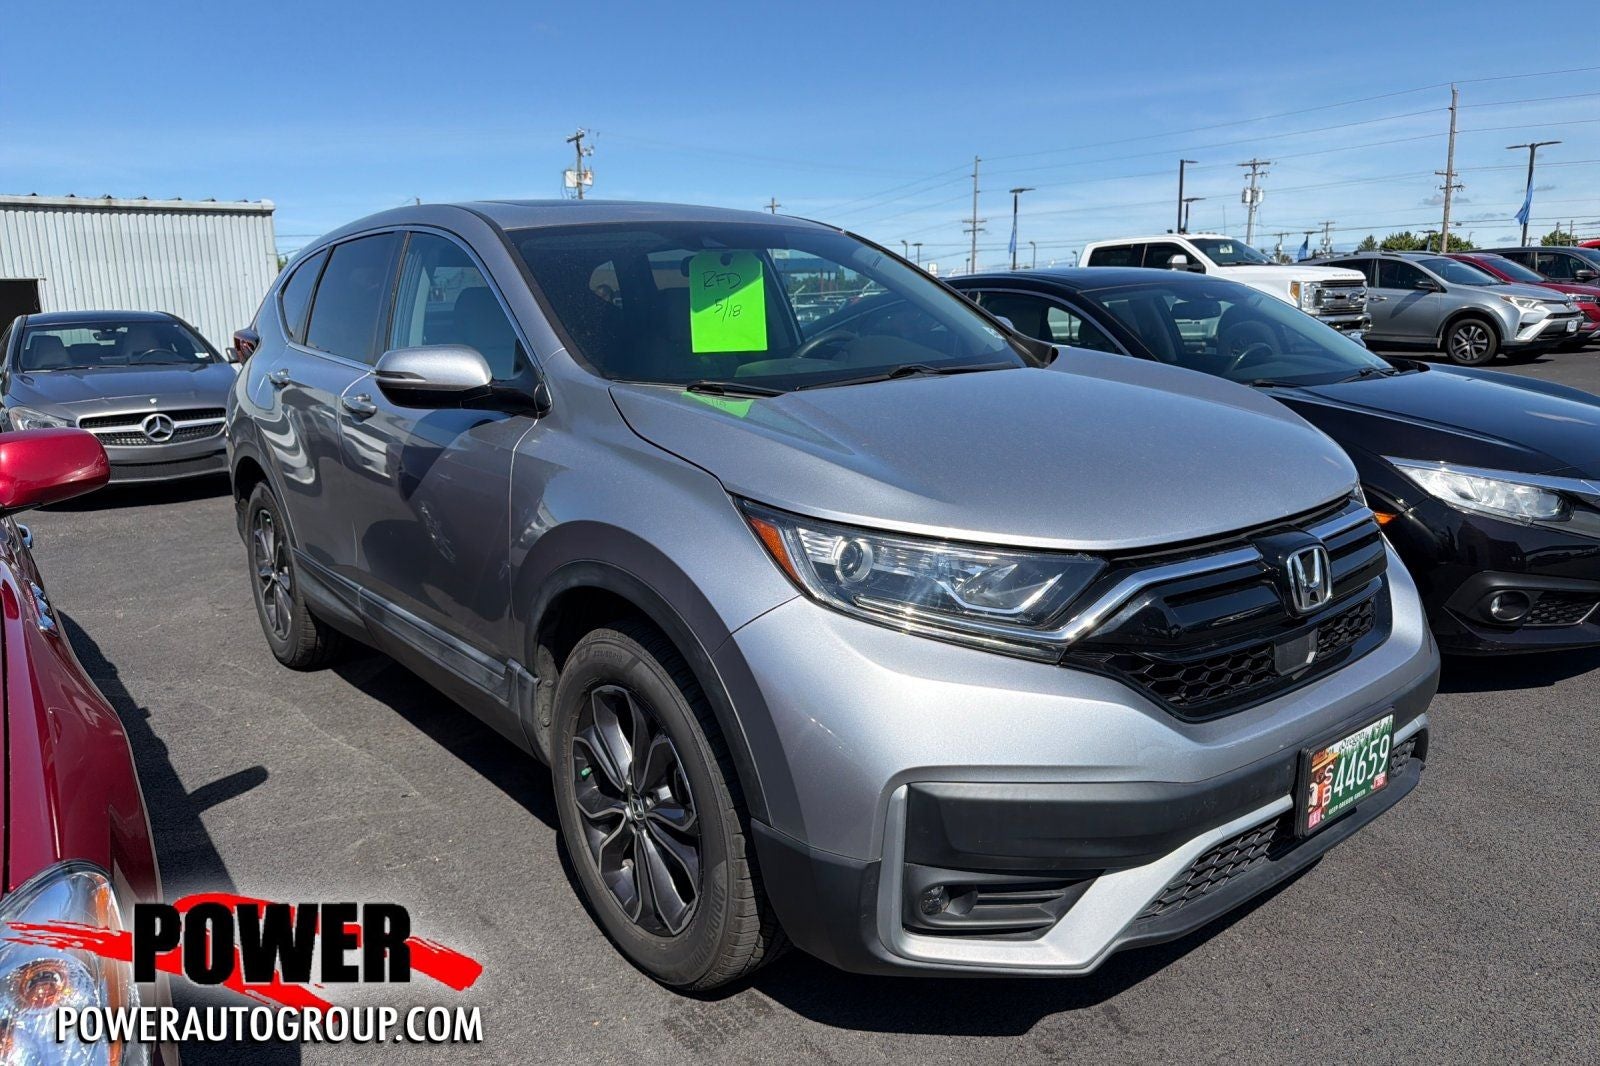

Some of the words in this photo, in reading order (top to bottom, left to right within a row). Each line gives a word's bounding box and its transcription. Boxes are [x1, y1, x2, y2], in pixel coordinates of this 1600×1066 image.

[702, 270, 742, 290] RFD
[714, 298, 742, 323] 5/18
[1333, 734, 1390, 797] 44659
